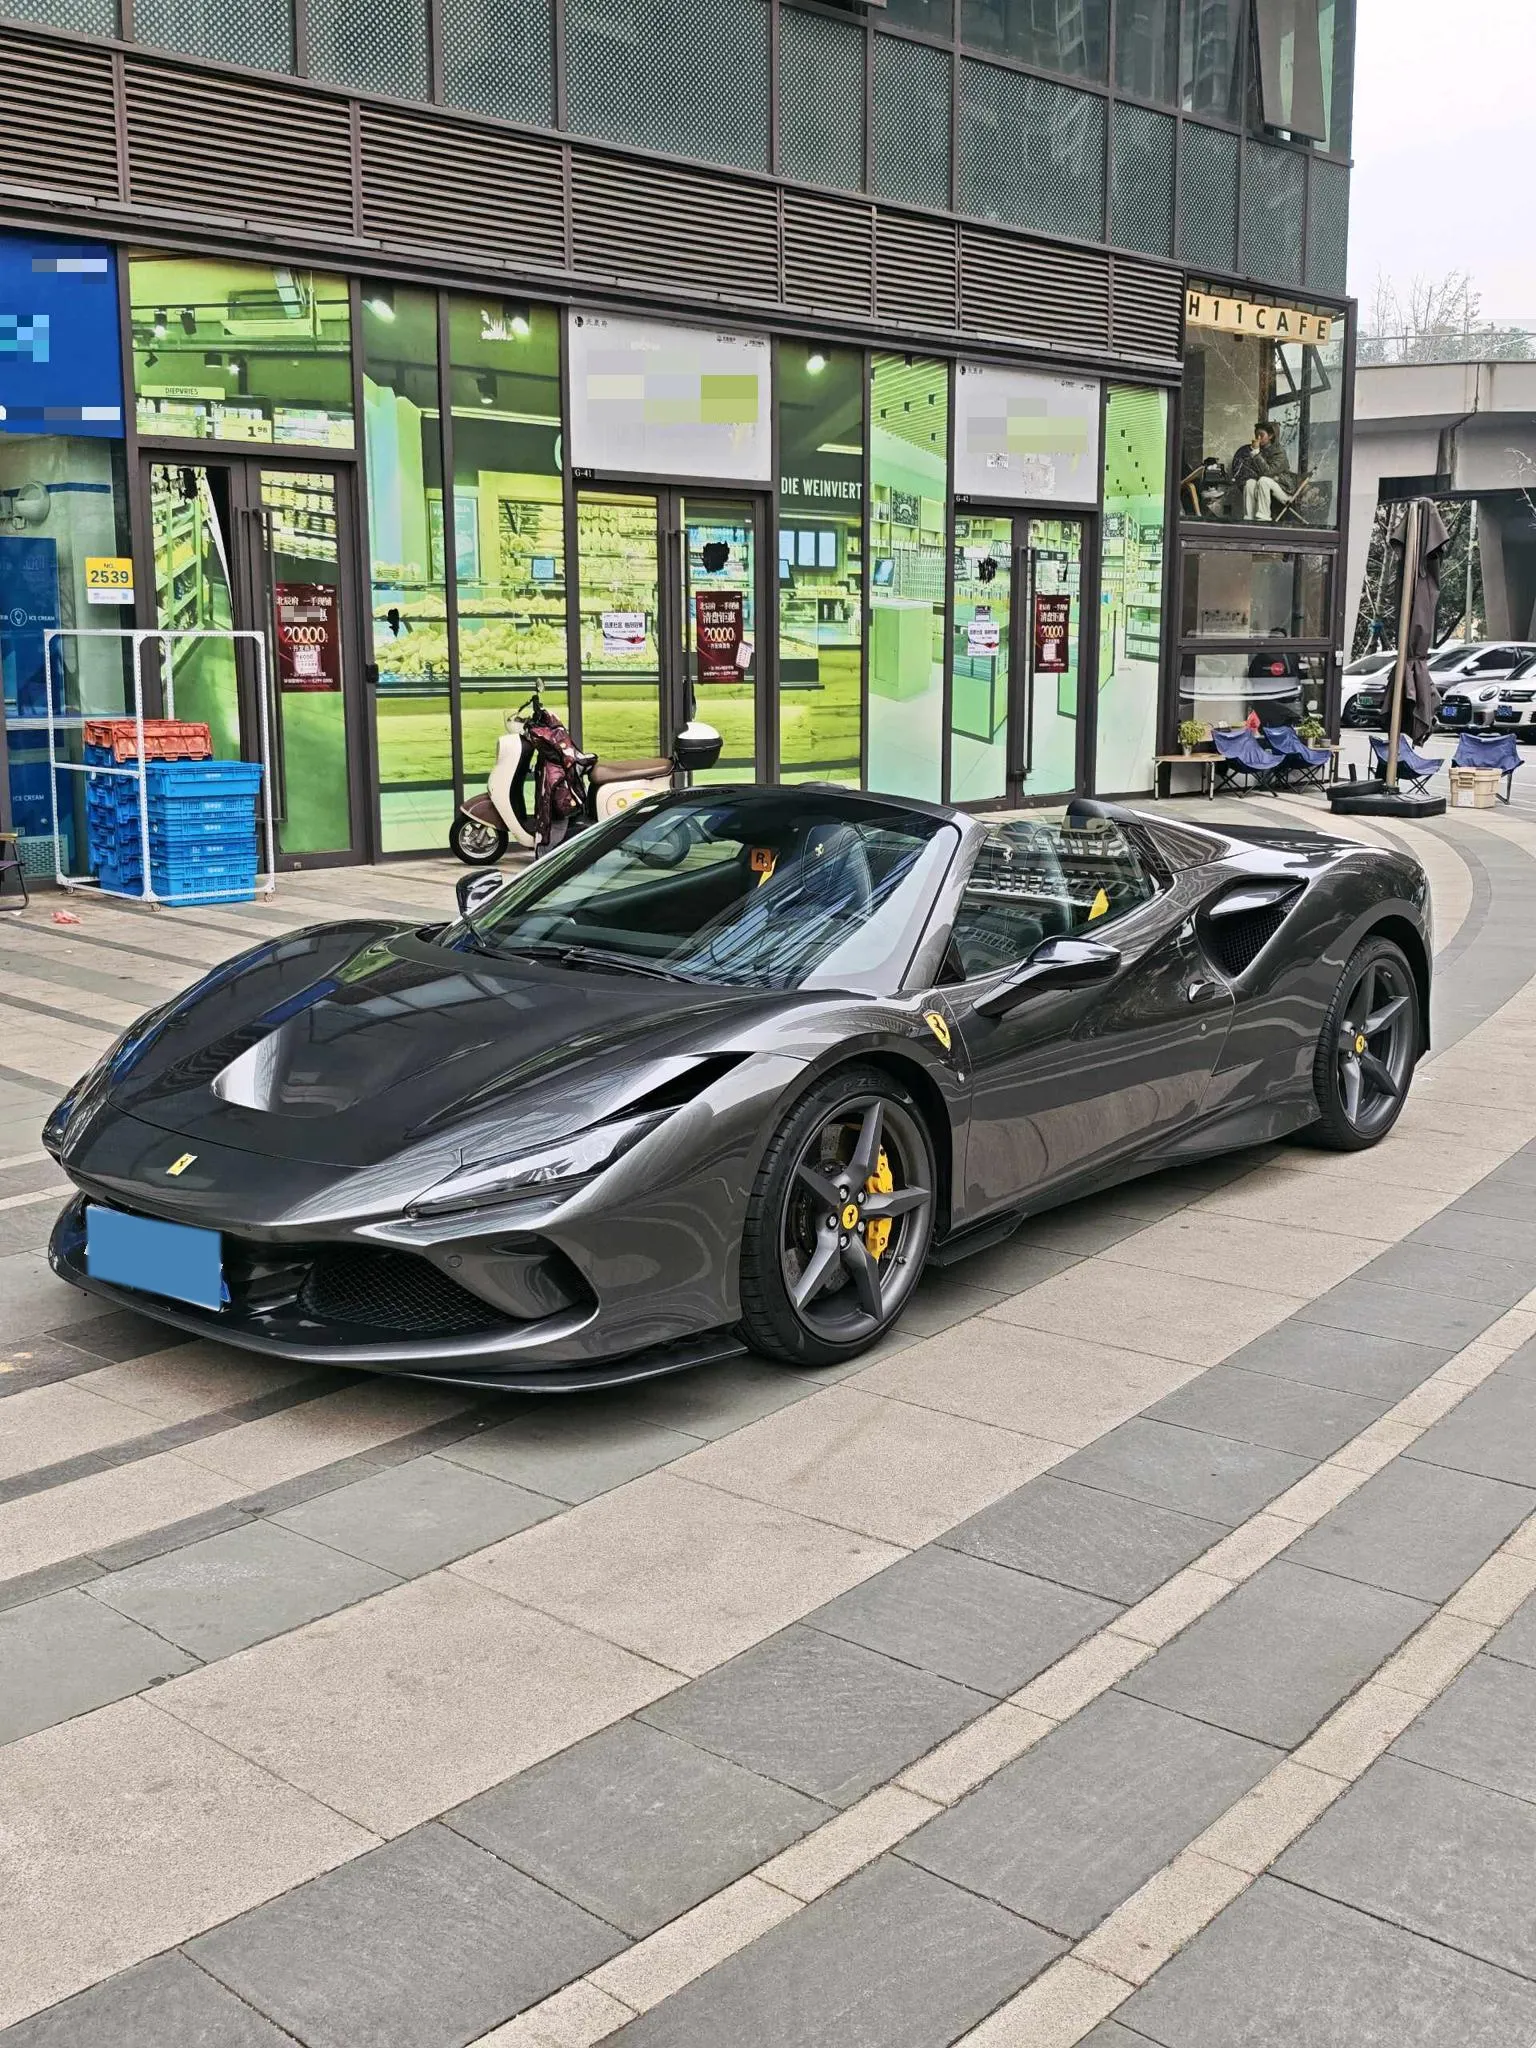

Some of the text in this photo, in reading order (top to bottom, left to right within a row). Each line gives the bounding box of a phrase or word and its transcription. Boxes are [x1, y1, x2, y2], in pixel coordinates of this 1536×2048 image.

[575, 468, 591, 477] G-41
[781, 477, 862, 500] DIE WEINVIERT
[90, 570, 129, 583] 2539
[283, 626, 326, 643] 20000
[704, 627, 735, 643] 20000
